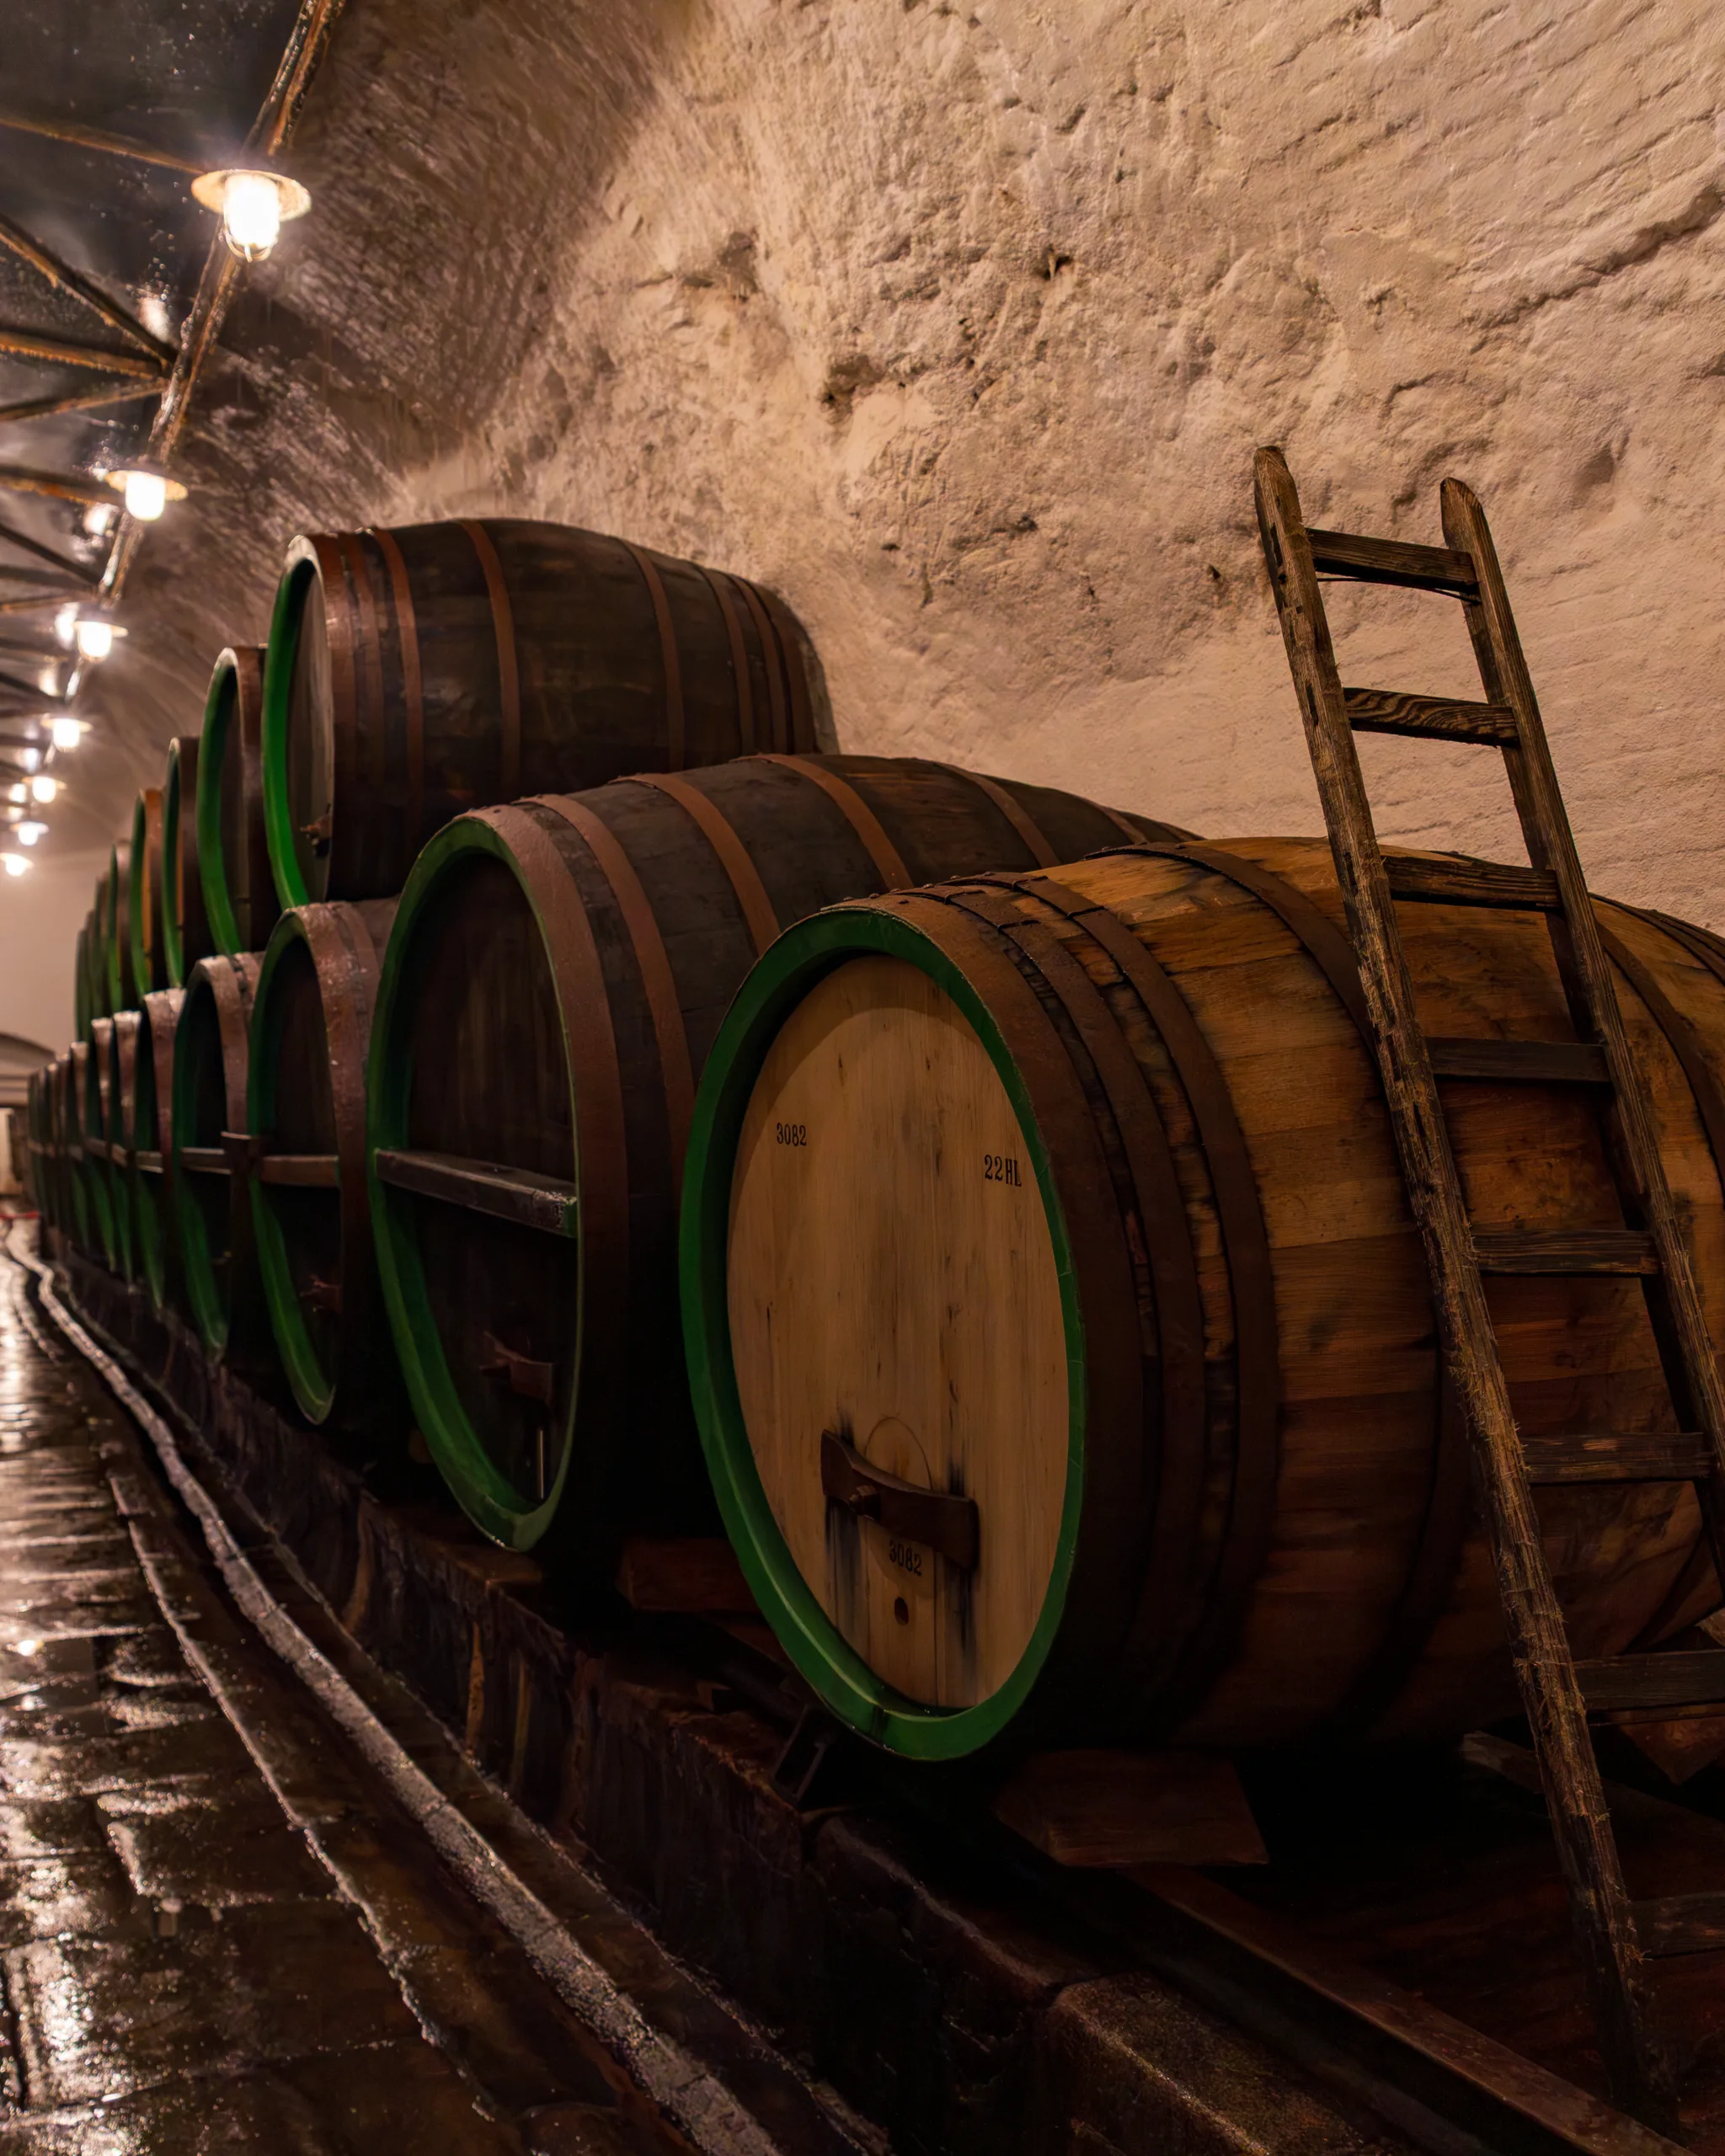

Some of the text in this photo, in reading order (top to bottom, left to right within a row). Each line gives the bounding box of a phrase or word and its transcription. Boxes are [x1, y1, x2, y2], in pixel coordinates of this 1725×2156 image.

[777, 1122, 807, 1146] 3082
[984, 1154, 1023, 1187] 22HL
[889, 1540, 921, 1577] 3082
